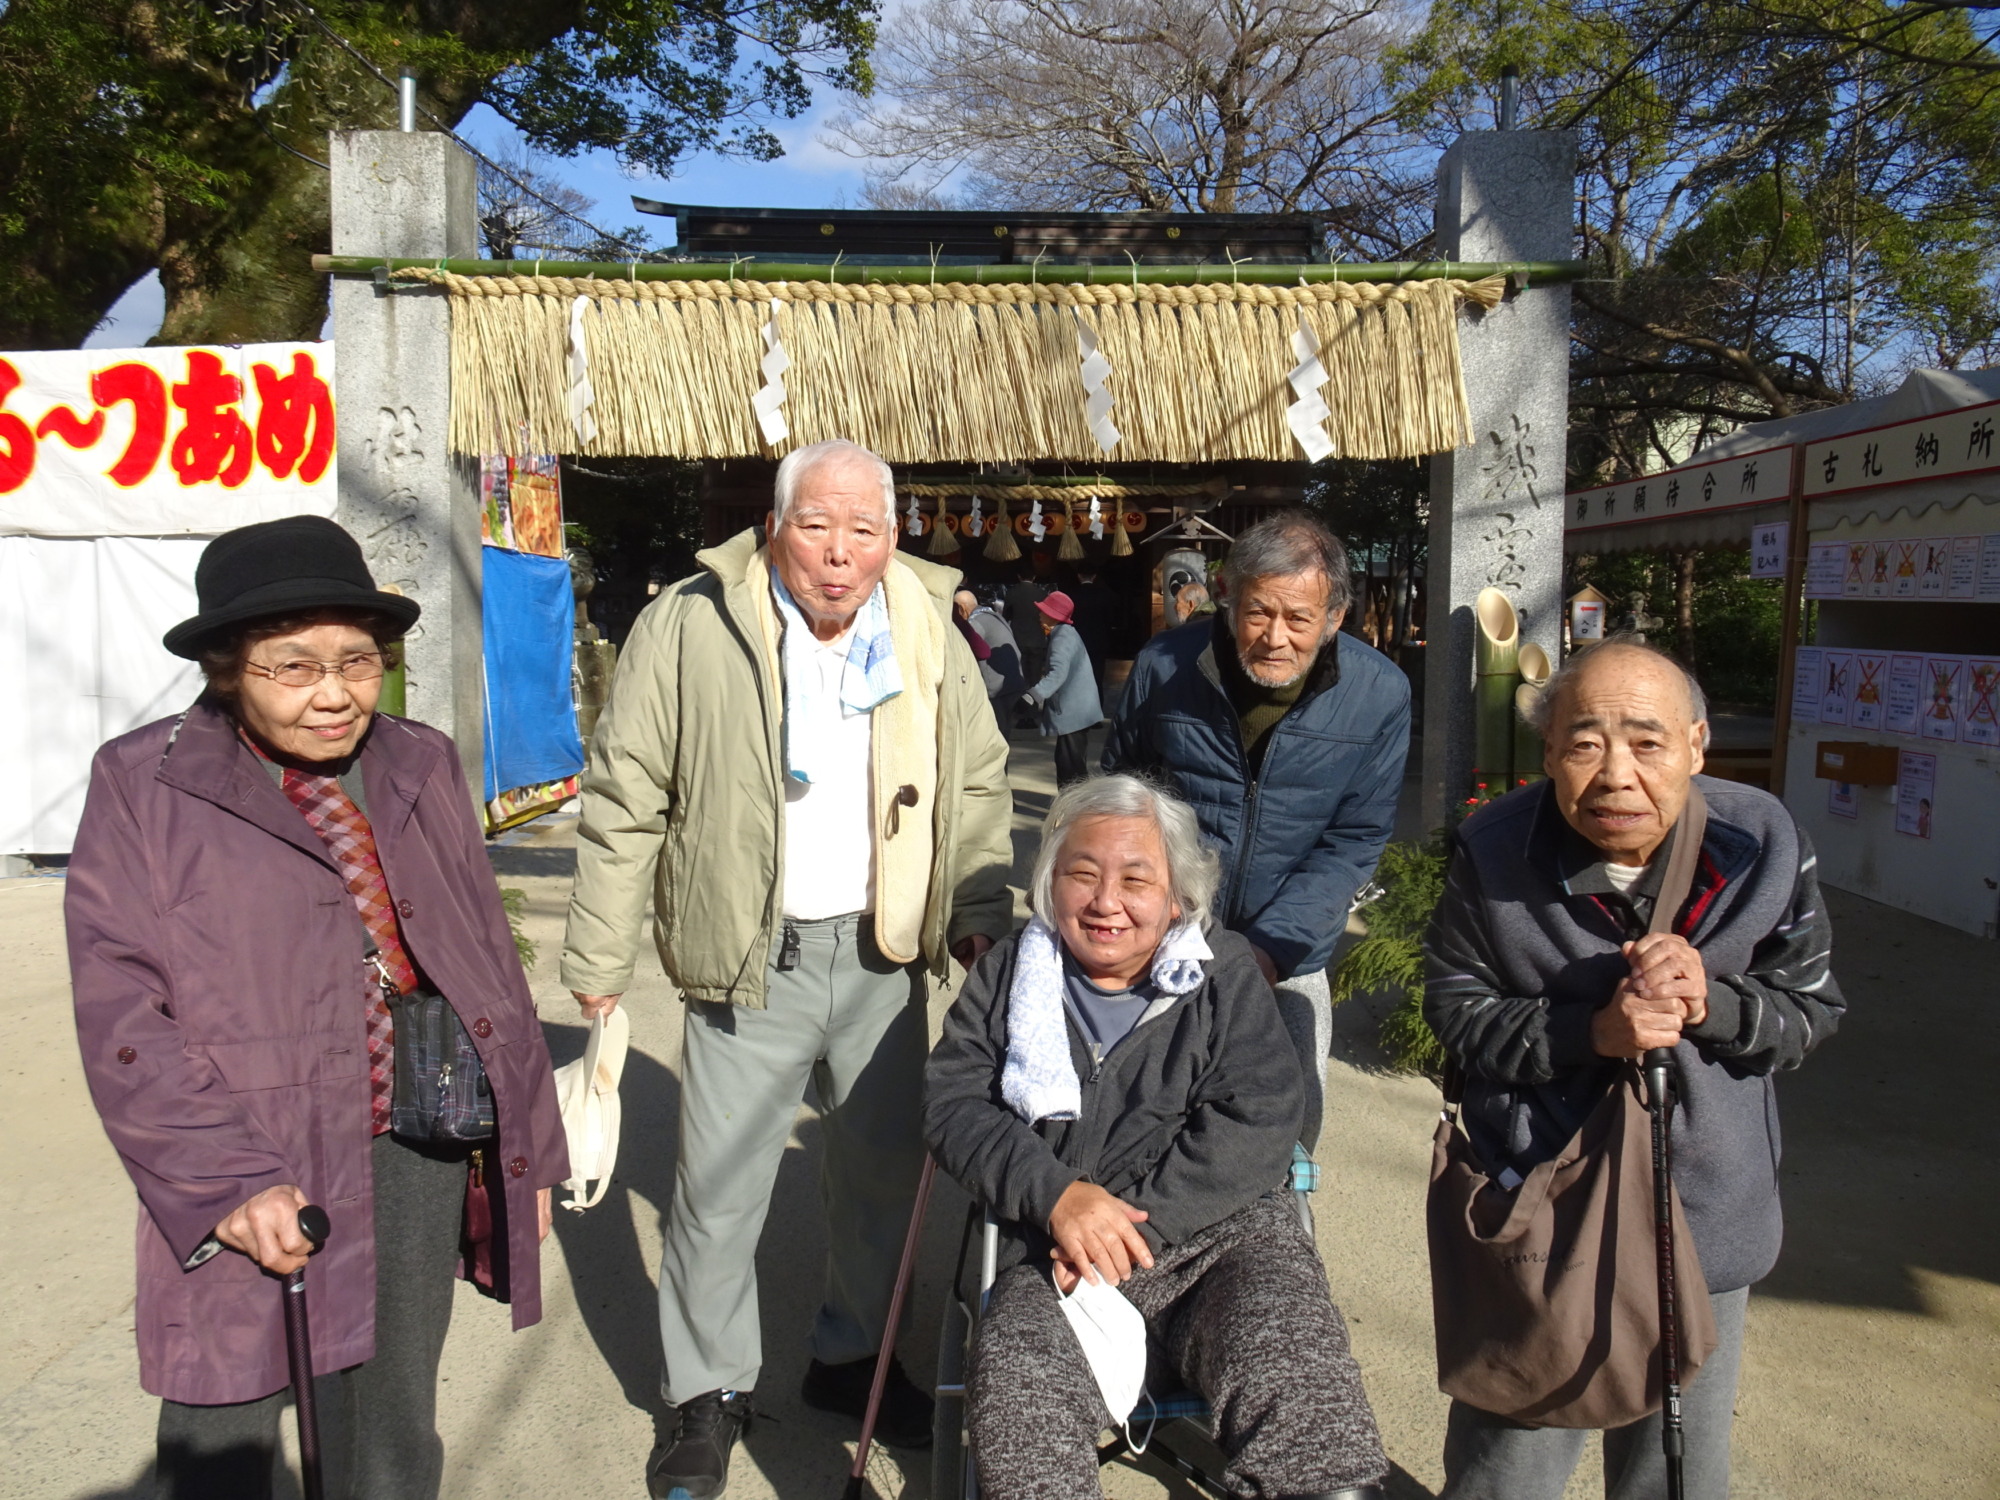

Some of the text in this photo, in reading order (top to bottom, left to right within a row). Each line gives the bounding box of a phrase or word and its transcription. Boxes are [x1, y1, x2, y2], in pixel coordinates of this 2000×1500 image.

[1822, 417, 1995, 484] 古札納所
[1576, 460, 1758, 521] 御祈願待合所
[1757, 554, 1779, 570] 記入所
[1581, 619, 1590, 634] 入口
